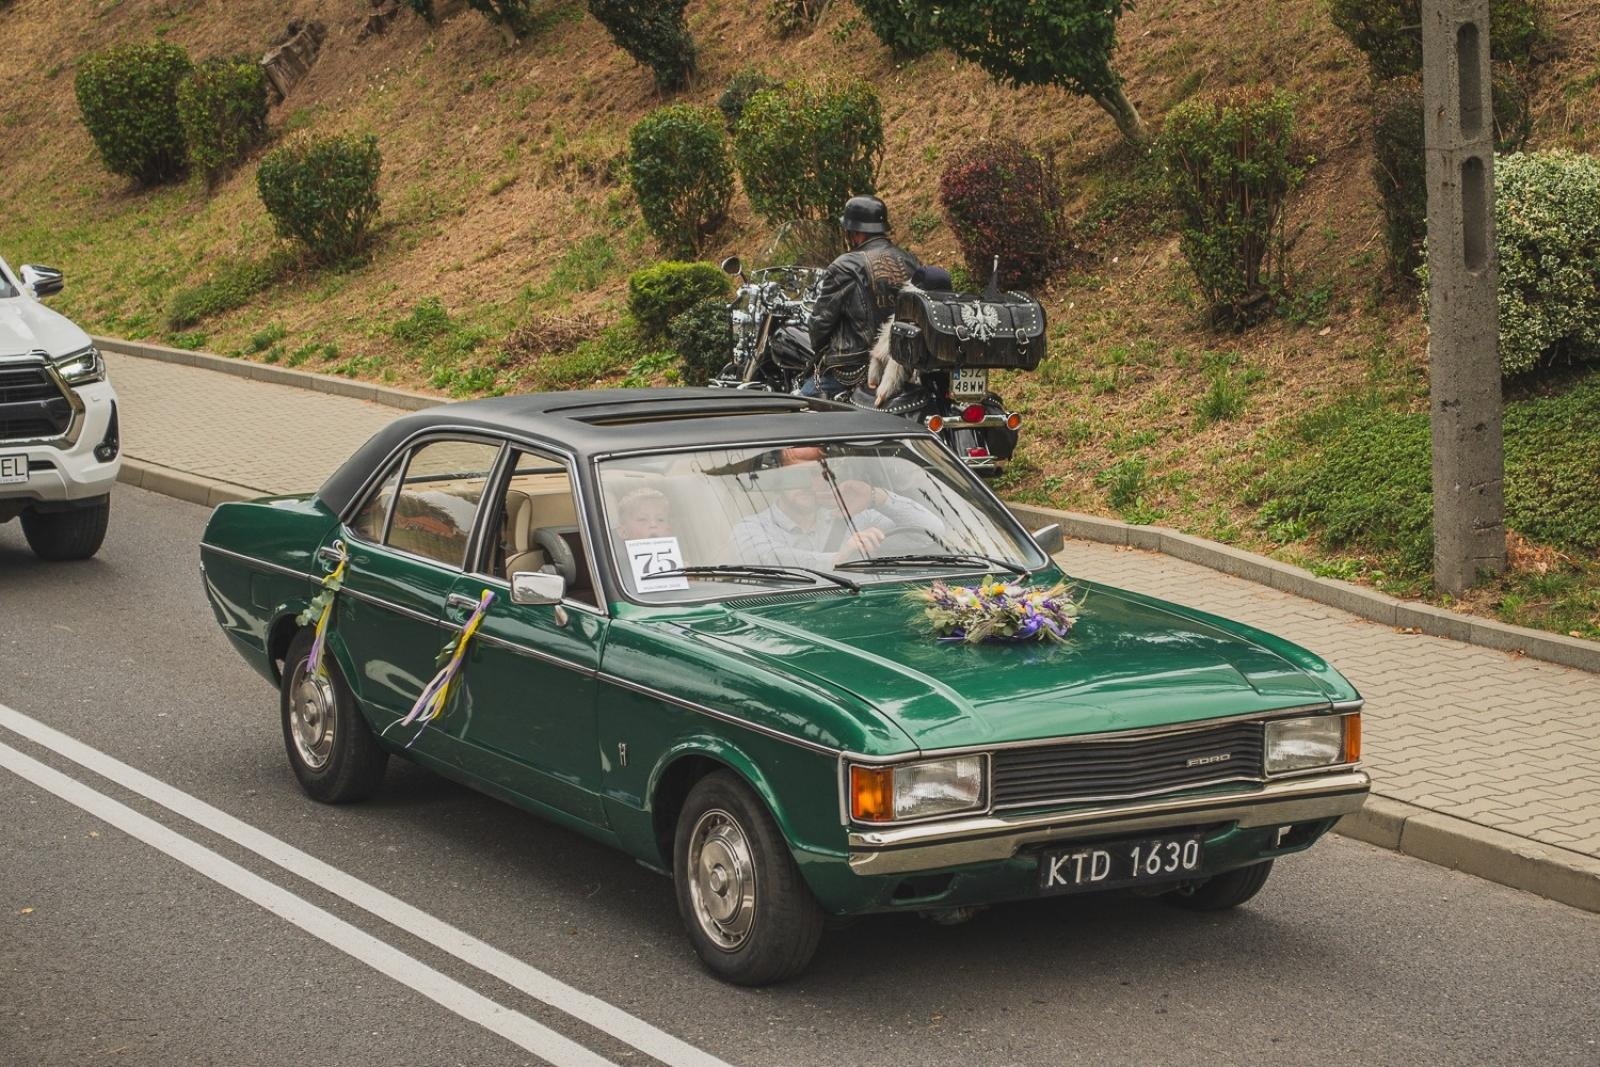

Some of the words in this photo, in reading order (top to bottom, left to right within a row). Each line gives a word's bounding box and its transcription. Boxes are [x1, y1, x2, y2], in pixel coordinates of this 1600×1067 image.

[955, 381, 984, 392] 48WW
[634, 548, 677, 575] 75
[1186, 753, 1231, 768] FORD
[1048, 850, 1111, 886] KTD
[1130, 839, 1199, 877] 1630
